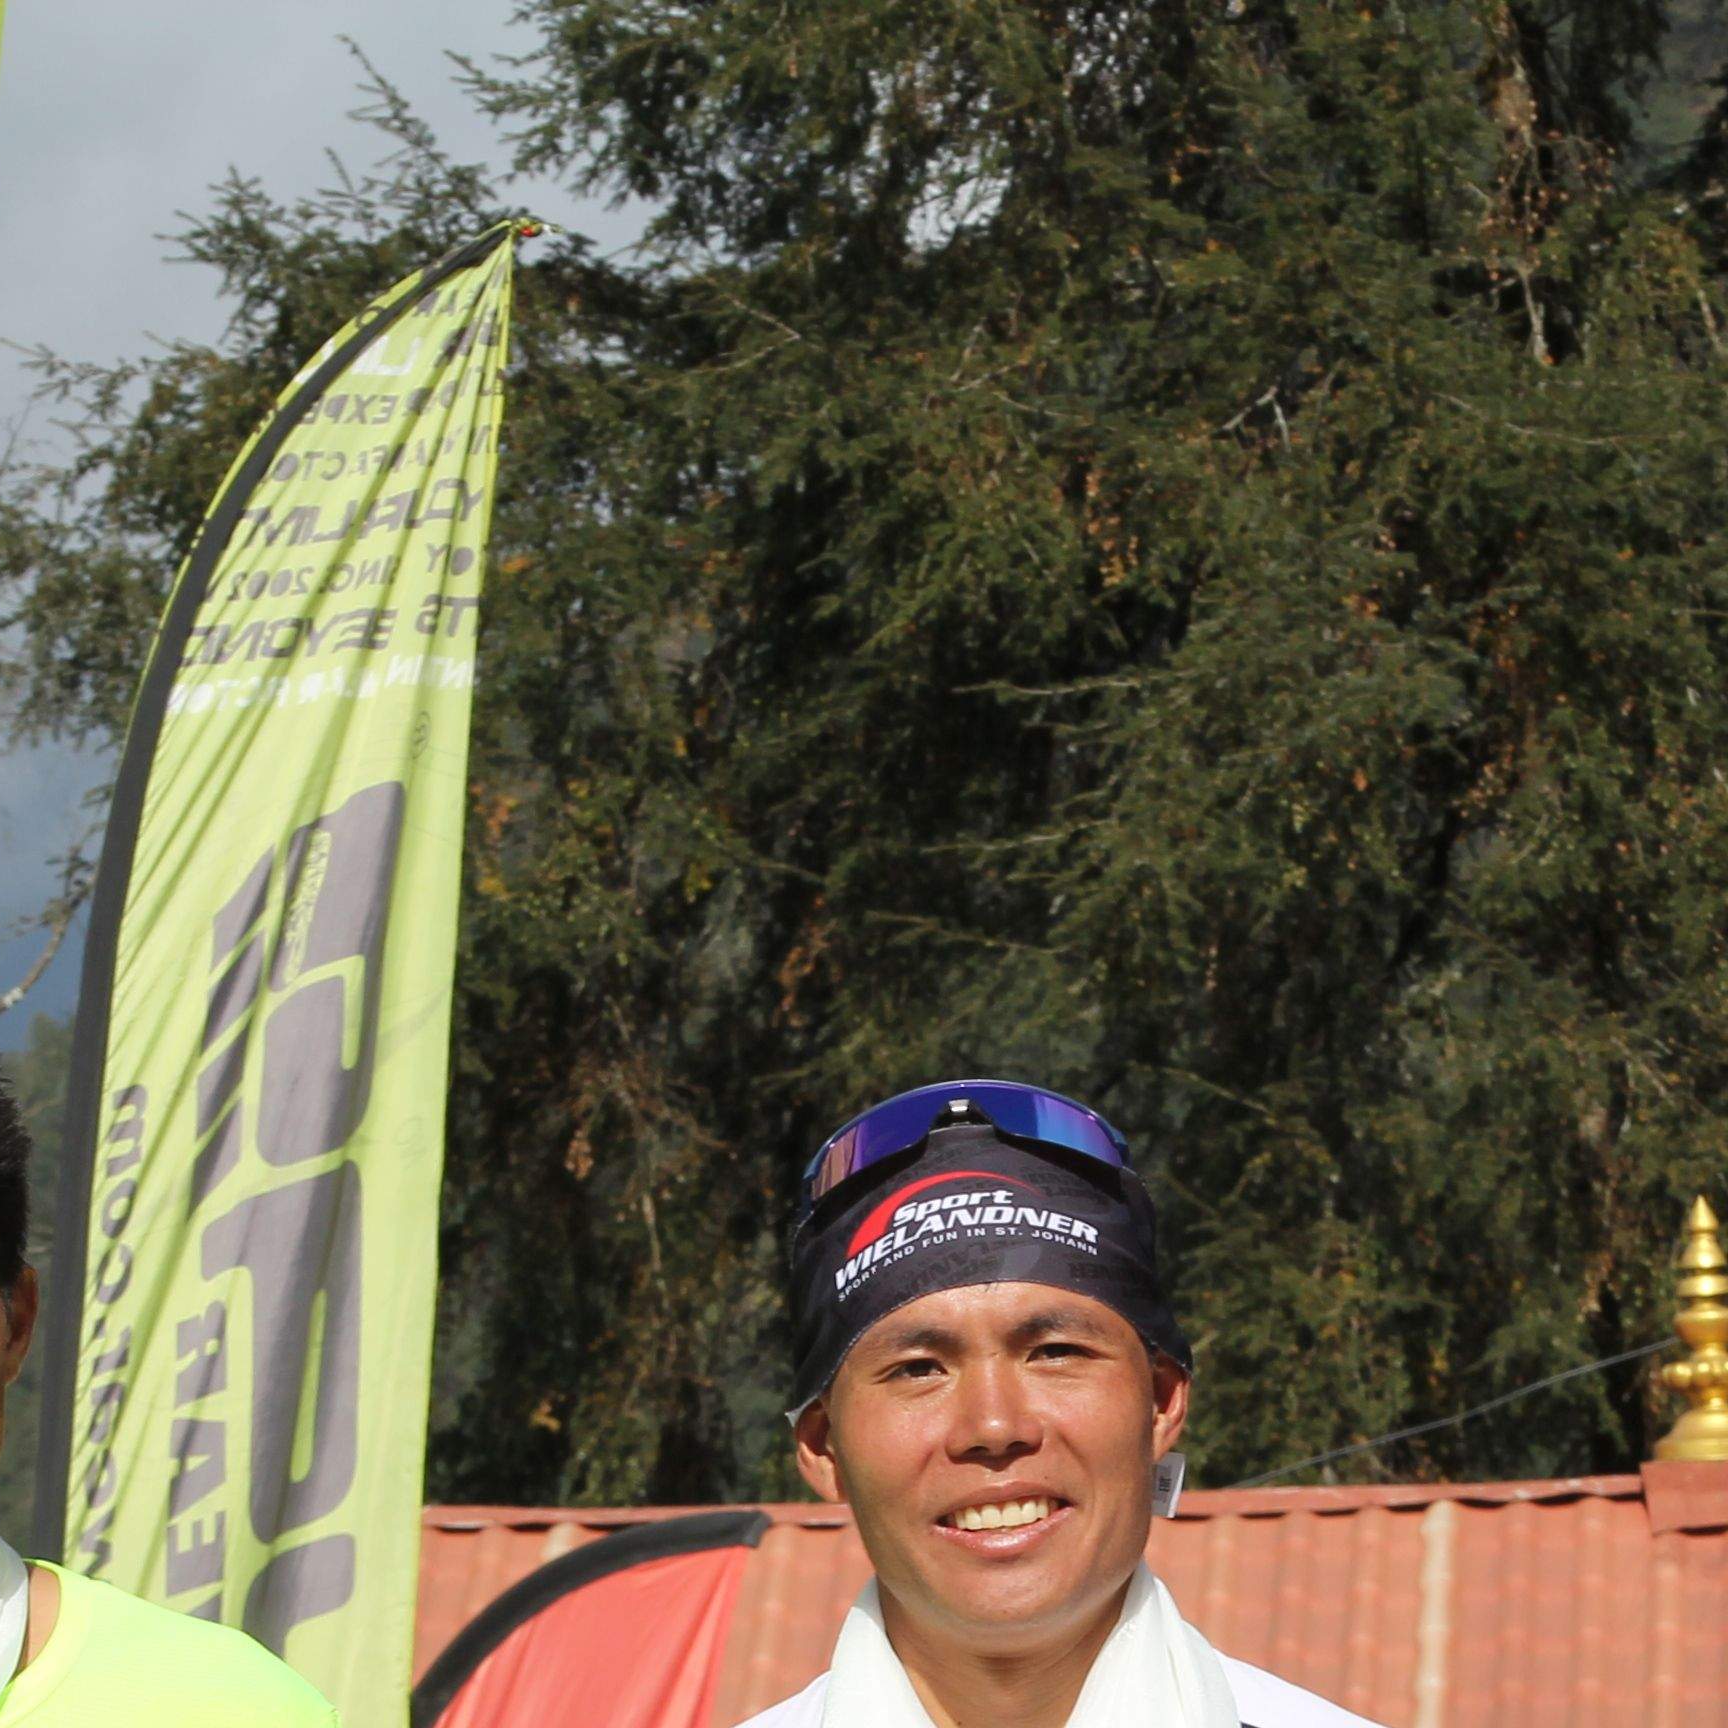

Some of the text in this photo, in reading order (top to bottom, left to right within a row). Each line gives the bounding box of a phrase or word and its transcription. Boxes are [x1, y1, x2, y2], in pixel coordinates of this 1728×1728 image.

[893, 1190, 1014, 1228] Sport
[835, 1205, 1099, 1291] WIELANDNER
[839, 1227, 1098, 1301] SPORT AND FUN IN ST. JOHANN
